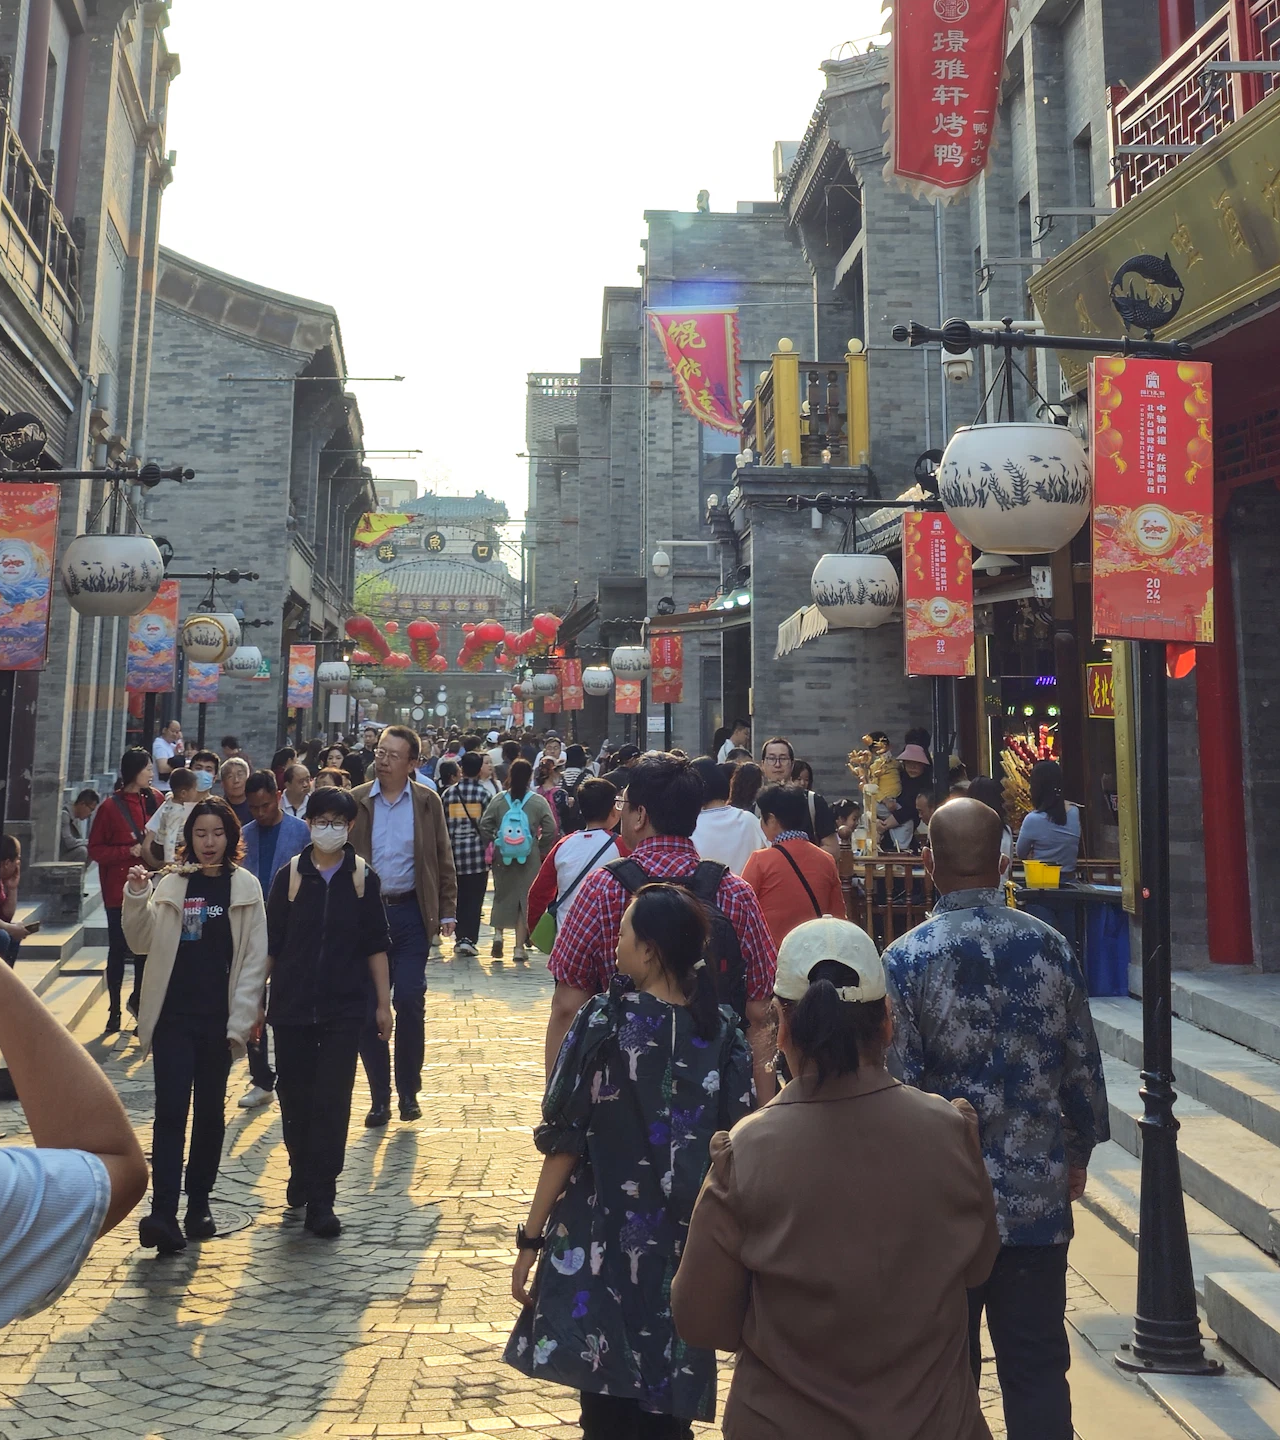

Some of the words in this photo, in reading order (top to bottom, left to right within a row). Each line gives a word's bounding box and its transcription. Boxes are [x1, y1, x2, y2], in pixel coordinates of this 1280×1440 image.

[931, 29, 970, 168] 璟雅轩烤鸭
[1146, 578, 1160, 589] 20
[1146, 589, 1160, 600] 24
